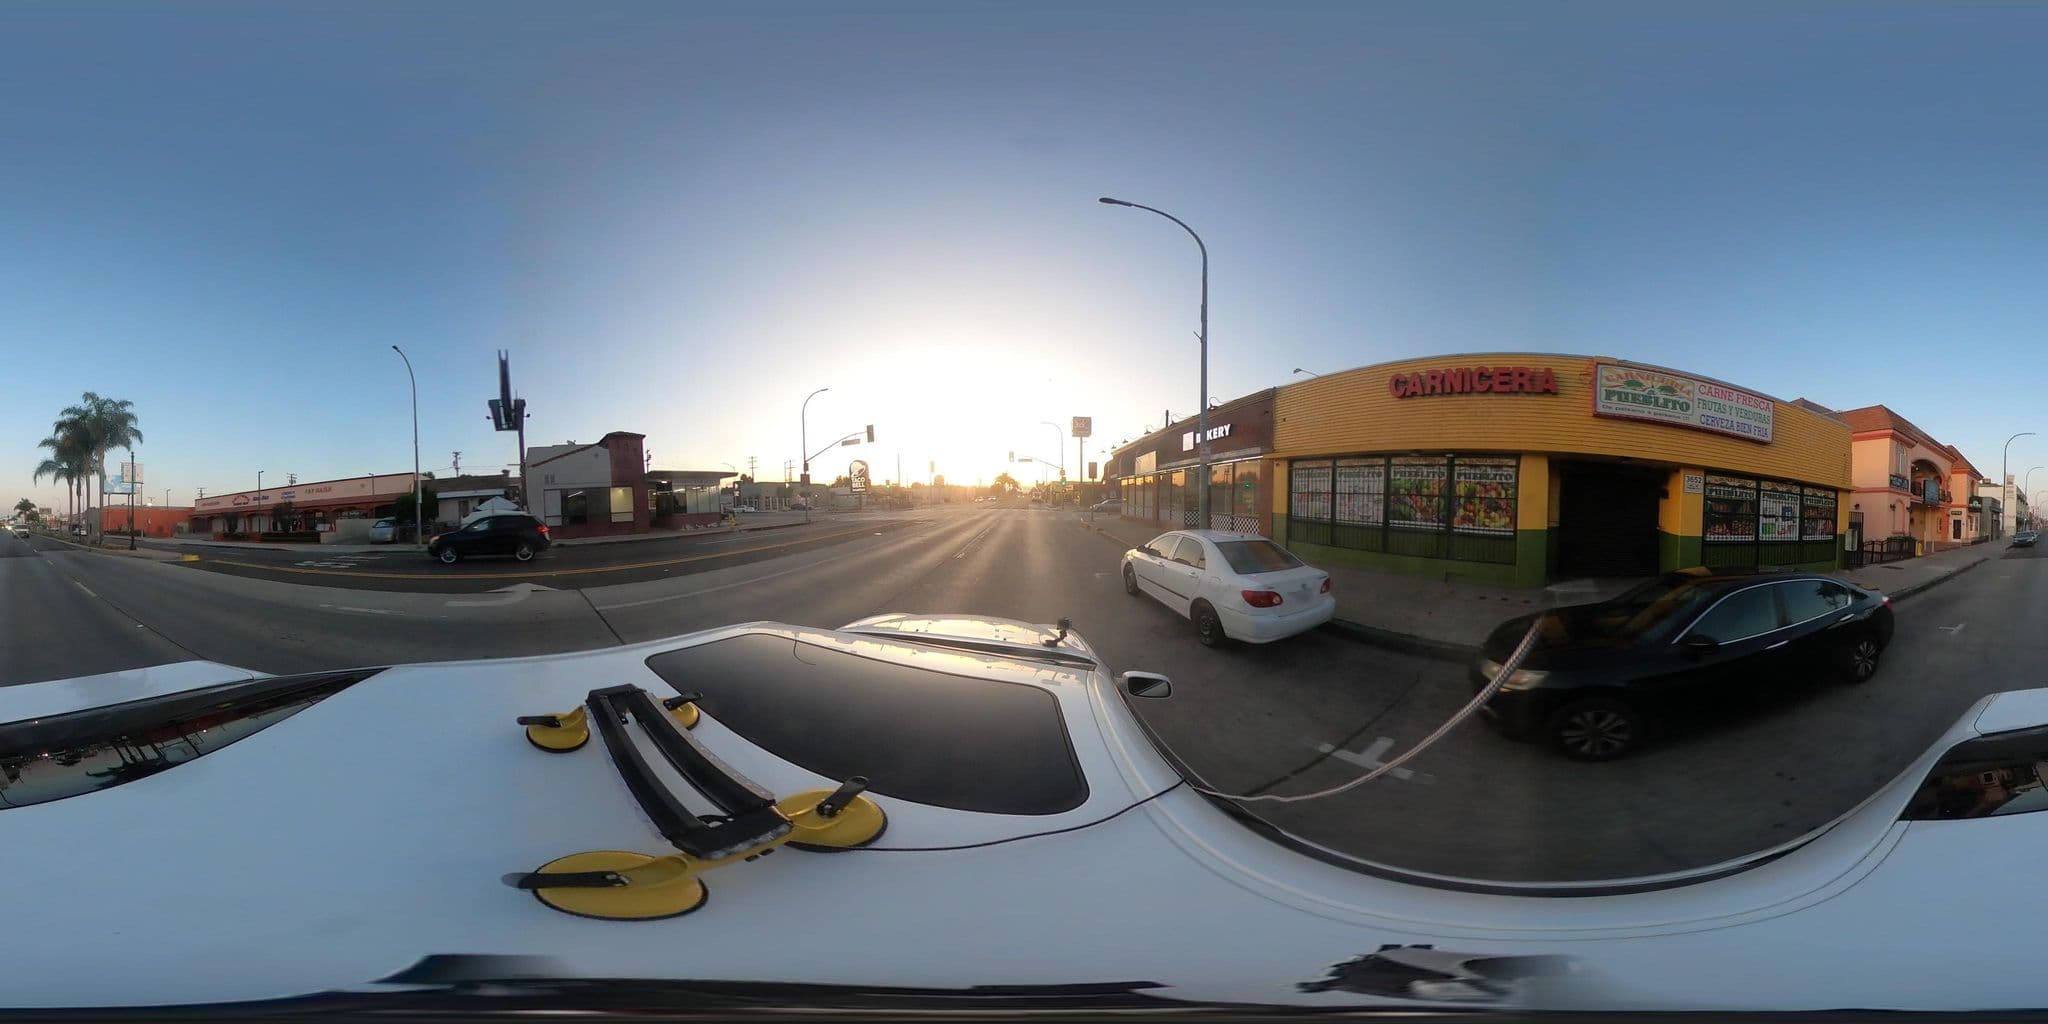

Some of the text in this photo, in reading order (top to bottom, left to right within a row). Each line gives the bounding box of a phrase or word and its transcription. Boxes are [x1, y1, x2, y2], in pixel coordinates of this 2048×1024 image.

[1604, 388, 1691, 413] PUEBLITO
[1698, 384, 1771, 413] CARNE FRESCA
[1697, 398, 1770, 425] FRUTAS Y VERDURAS
[1196, 424, 1231, 444] BKERY
[1700, 414, 1769, 438] CERVEZA BIEN FRIA
